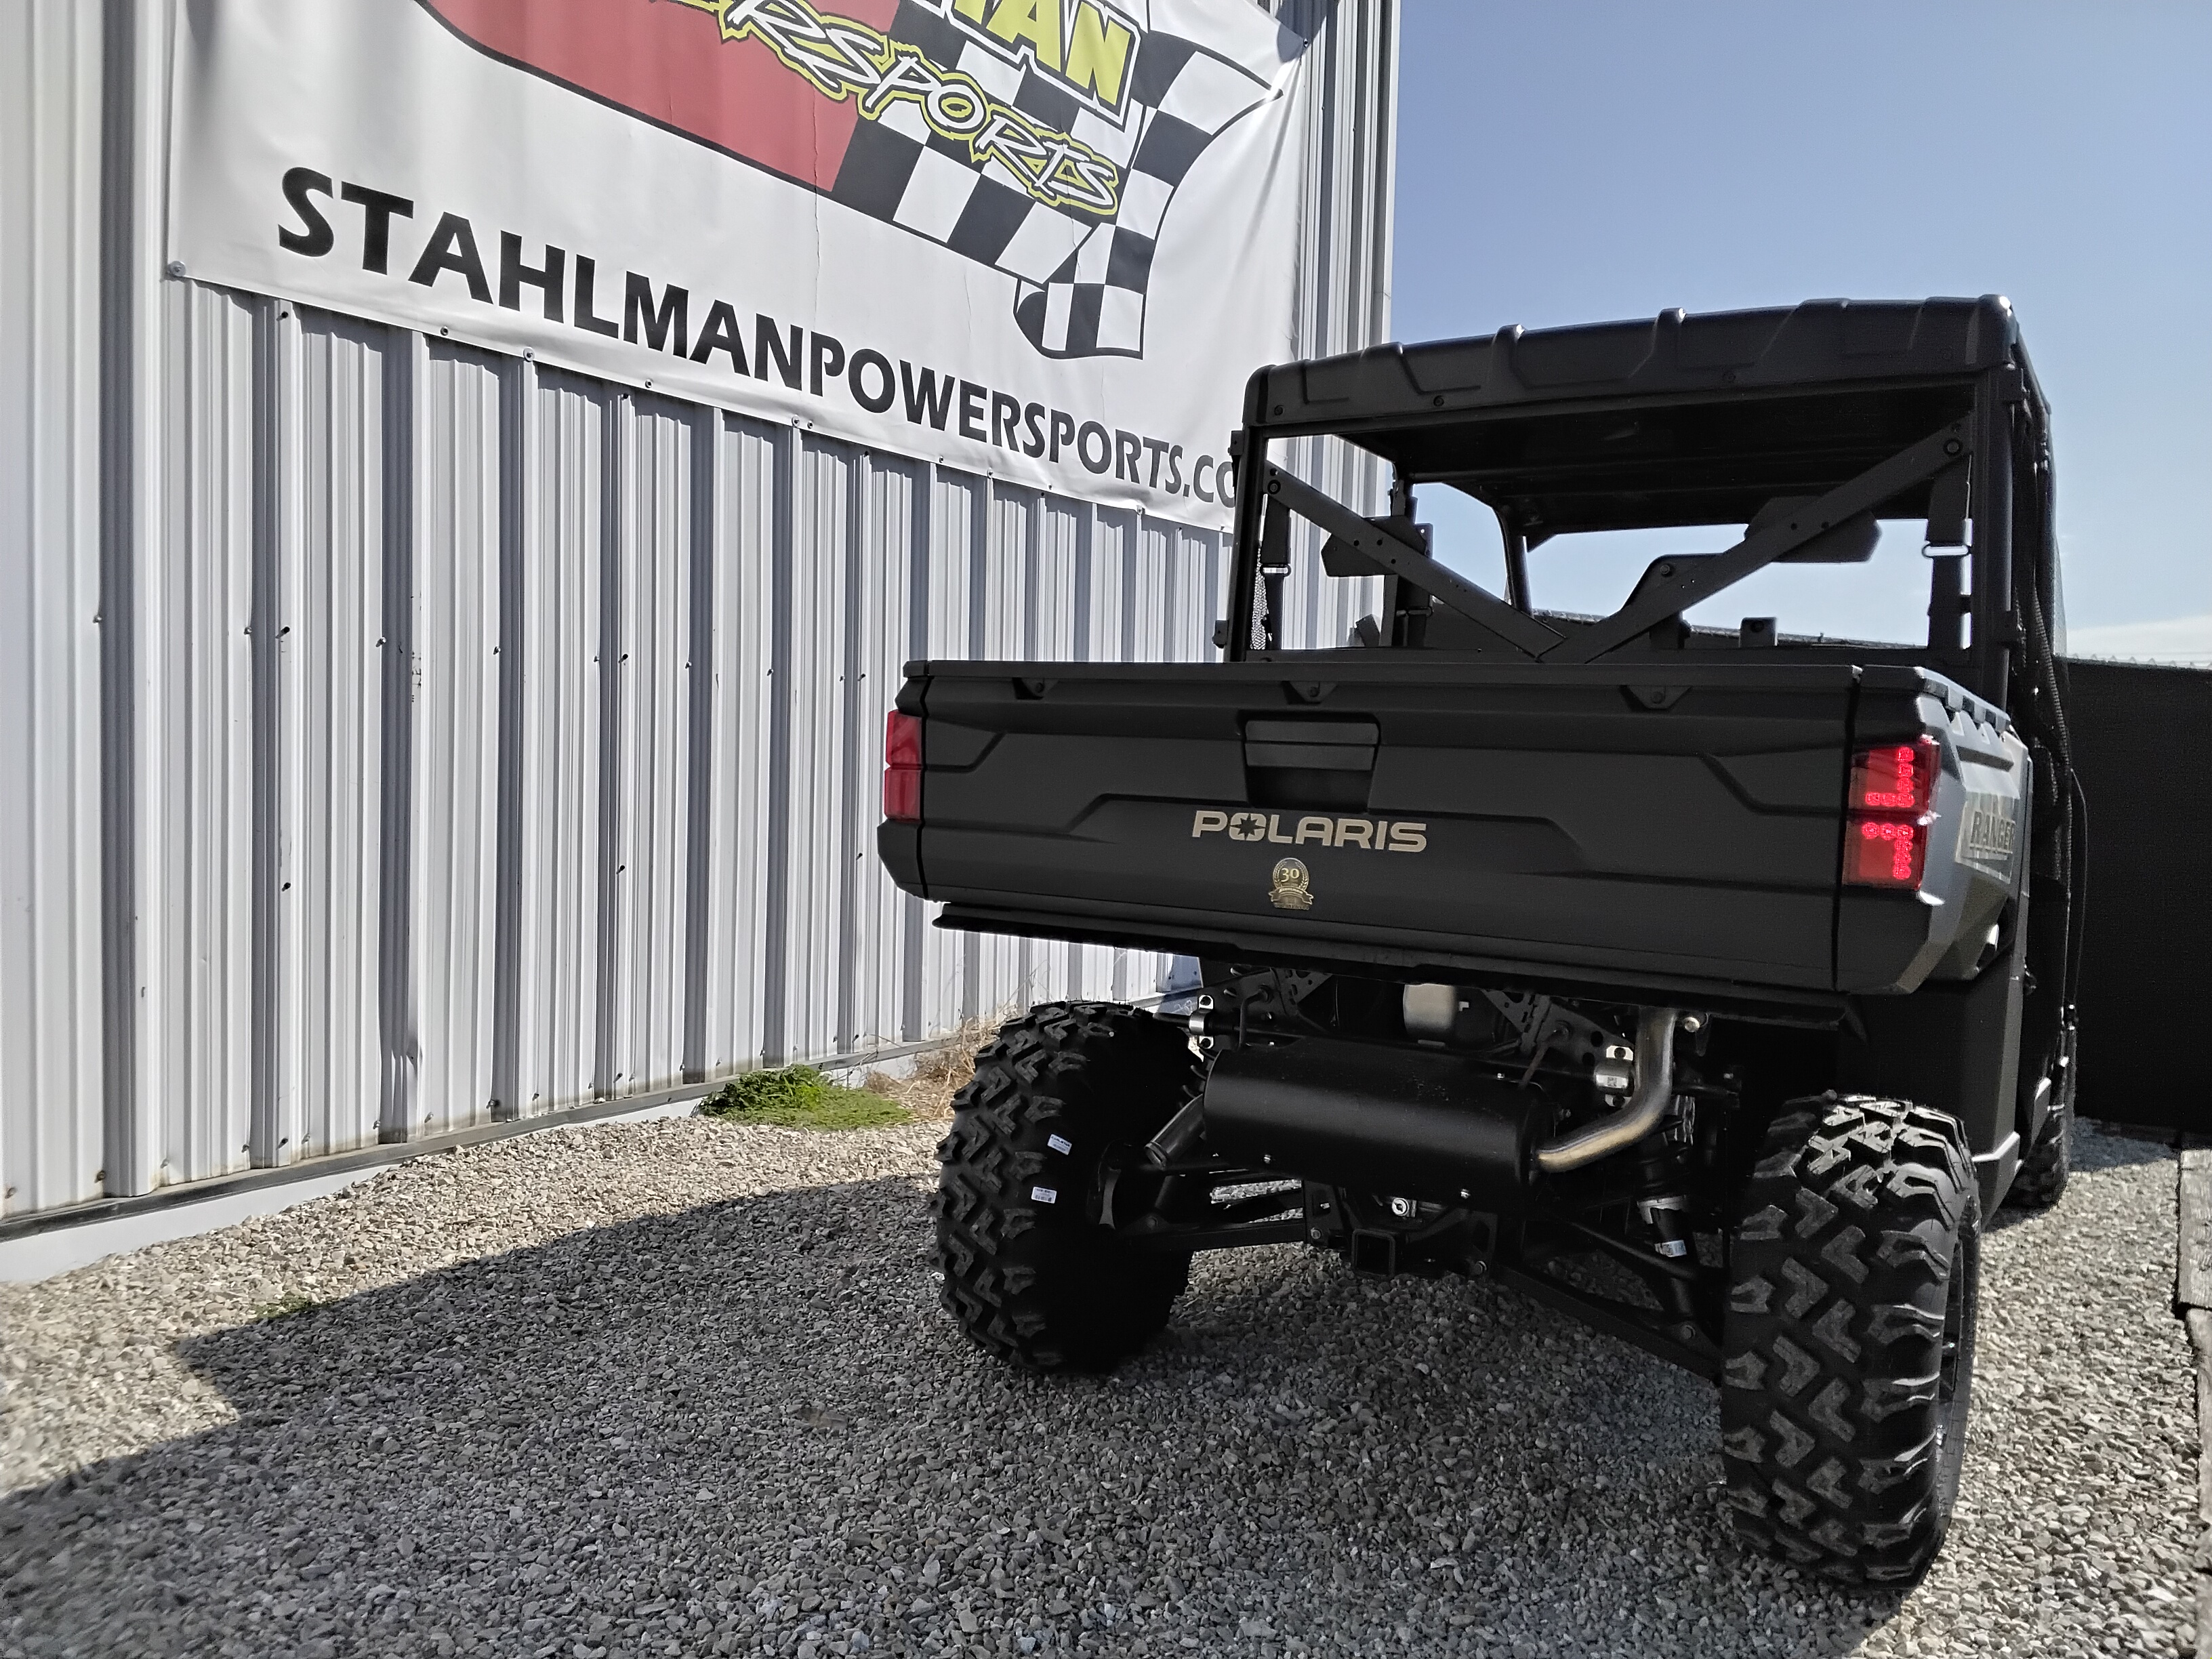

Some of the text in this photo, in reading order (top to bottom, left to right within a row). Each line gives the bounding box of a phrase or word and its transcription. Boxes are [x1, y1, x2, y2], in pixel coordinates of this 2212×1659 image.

[1191, 810, 1427, 853] POLARIS
[1969, 811, 2015, 852] RANGER
[1280, 867, 1300, 882] 30
